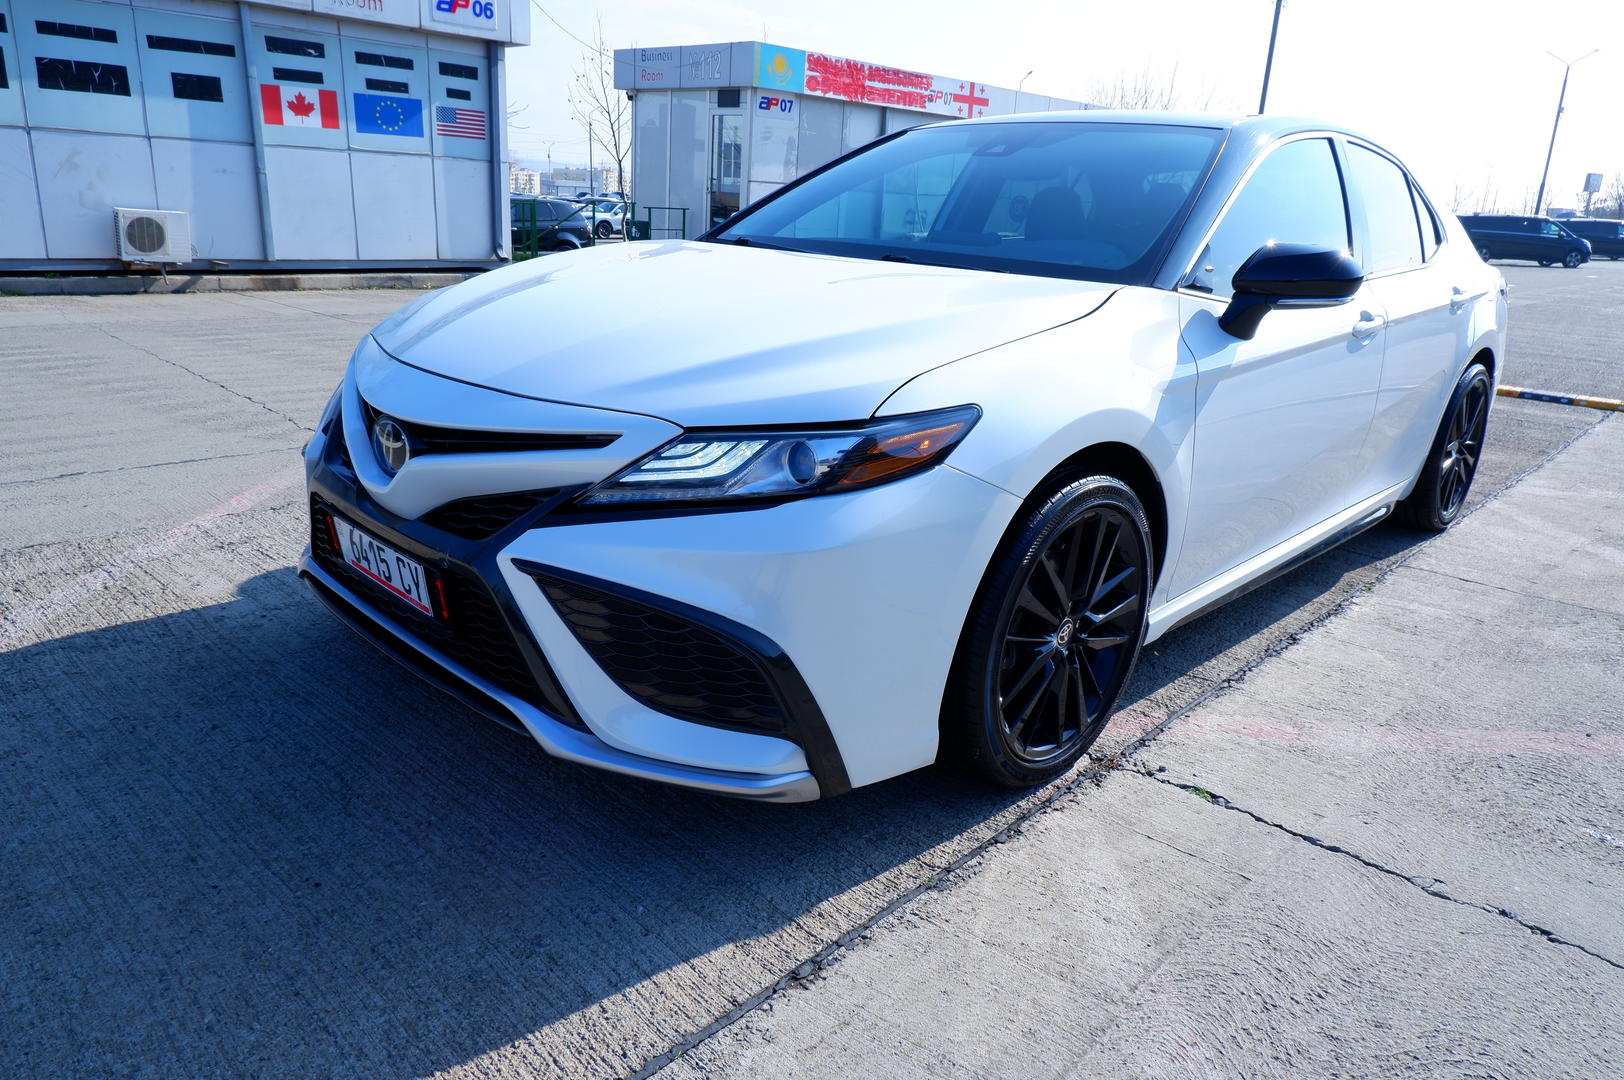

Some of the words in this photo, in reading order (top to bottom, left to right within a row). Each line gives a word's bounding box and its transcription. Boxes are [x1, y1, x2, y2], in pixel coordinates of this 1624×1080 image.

[472, 0, 494, 19] 06
[641, 49, 673, 62] Business
[641, 68, 664, 81] Room
[780, 98, 794, 113] 07
[943, 92, 953, 106] 07
[349, 528, 393, 584] 6415
[395, 555, 423, 603] CY
